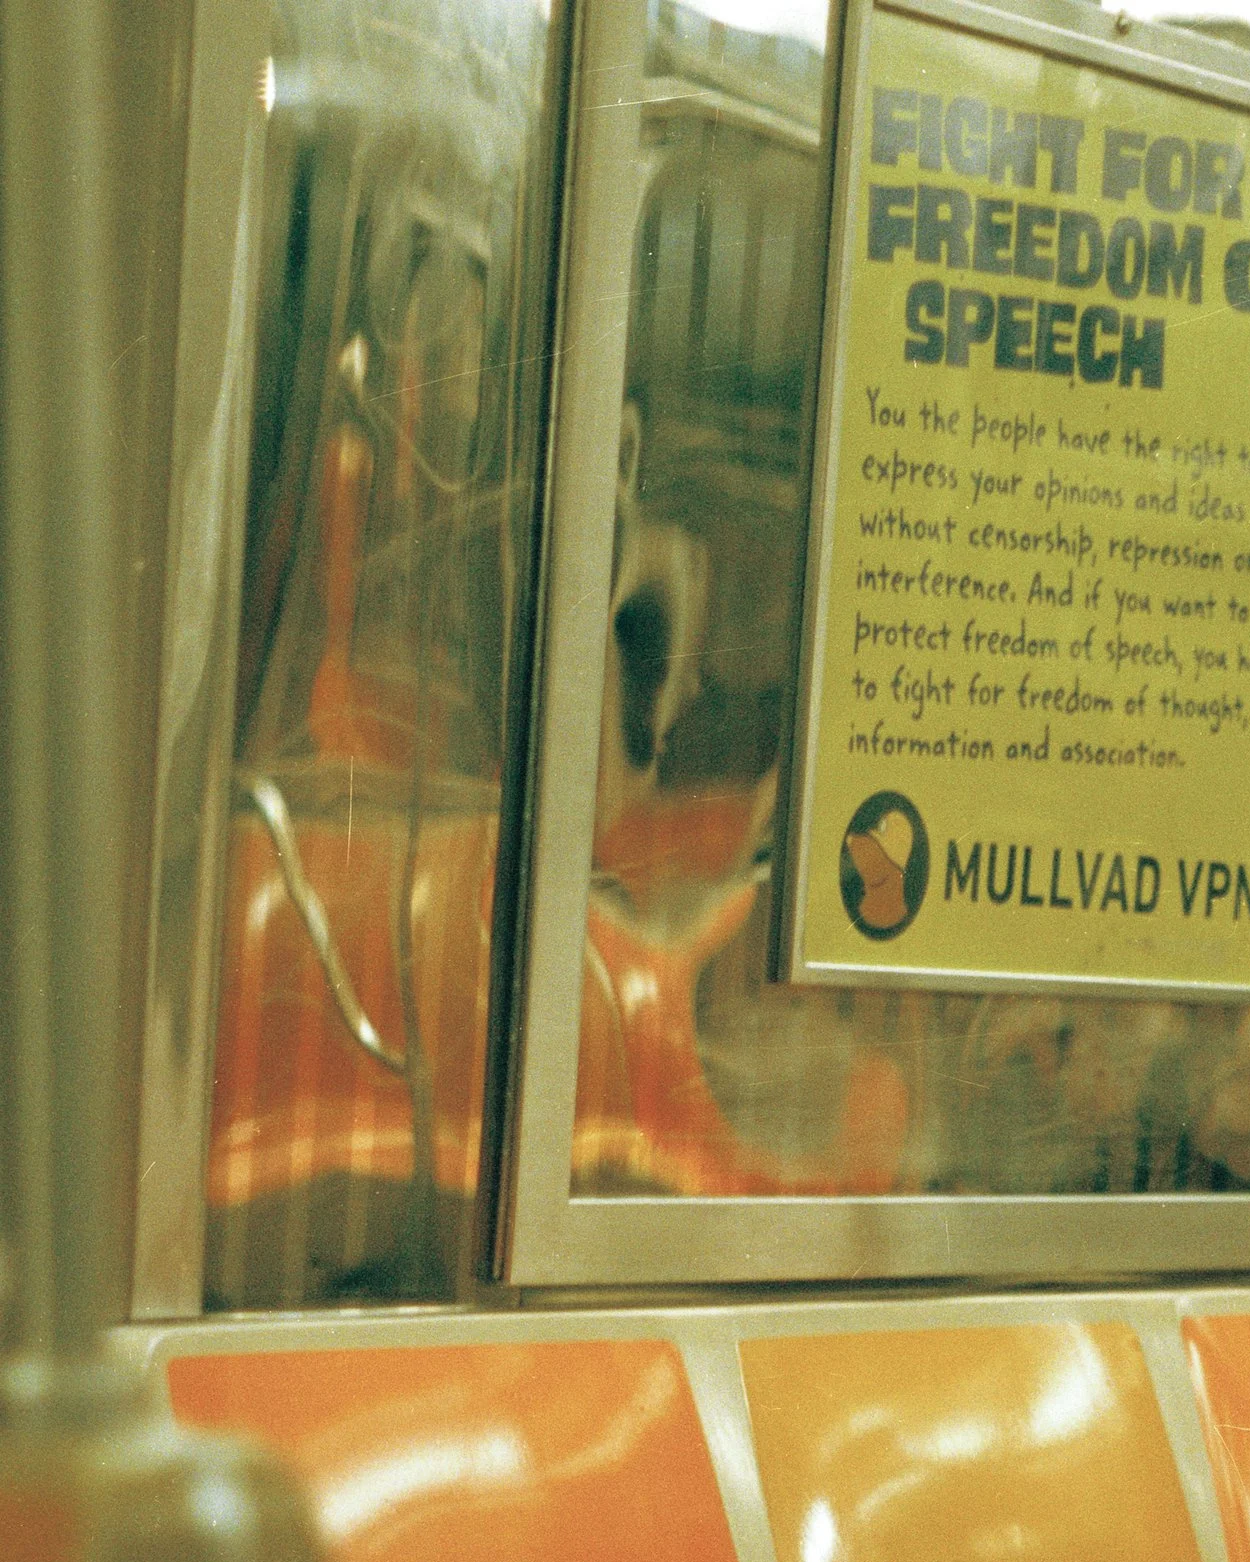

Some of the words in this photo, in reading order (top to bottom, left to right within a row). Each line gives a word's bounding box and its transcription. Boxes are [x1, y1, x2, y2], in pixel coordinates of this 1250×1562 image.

[872, 85, 1085, 195] FIGHT
[1102, 128, 1244, 220] FOR
[867, 184, 1206, 305] FREEDOM
[904, 279, 1165, 390] SPEECH
[866, 386, 905, 427] You
[919, 400, 960, 435] the
[971, 404, 1046, 453] people
[1057, 417, 1110, 455] have
[1124, 428, 1160, 462] the
[1172, 437, 1227, 480] right
[862, 449, 958, 494] express
[970, 468, 1022, 505] your
[1034, 467, 1124, 512] opinions
[1135, 477, 1178, 514] and
[1188, 481, 1245, 522] ideas
[859, 506, 957, 545] without
[968, 522, 1097, 568] censorship,
[1108, 535, 1224, 573] repression
[856, 558, 1016, 602] interference.
[1027, 569, 1074, 607] And
[1085, 576, 1102, 609] if
[1114, 587, 1151, 626] you
[1164, 592, 1216, 620] want
[1228, 596, 1249, 623] to
[854, 610, 950, 655] protect
[962, 618, 1059, 659] freedom
[1069, 625, 1096, 662] of
[1105, 632, 1182, 677] speech,
[1193, 643, 1227, 683] you
[852, 669, 877, 702] to
[890, 664, 954, 721] fight
[967, 672, 1004, 706] for
[1017, 672, 1113, 716] freedom
[1125, 684, 1149, 716] of
[1159, 687, 1248, 733] thought,
[849, 720, 994, 760] information
[1005, 723, 1050, 761] and
[1060, 738, 1186, 769] association.
[944, 840, 1161, 915] MULLVAD
